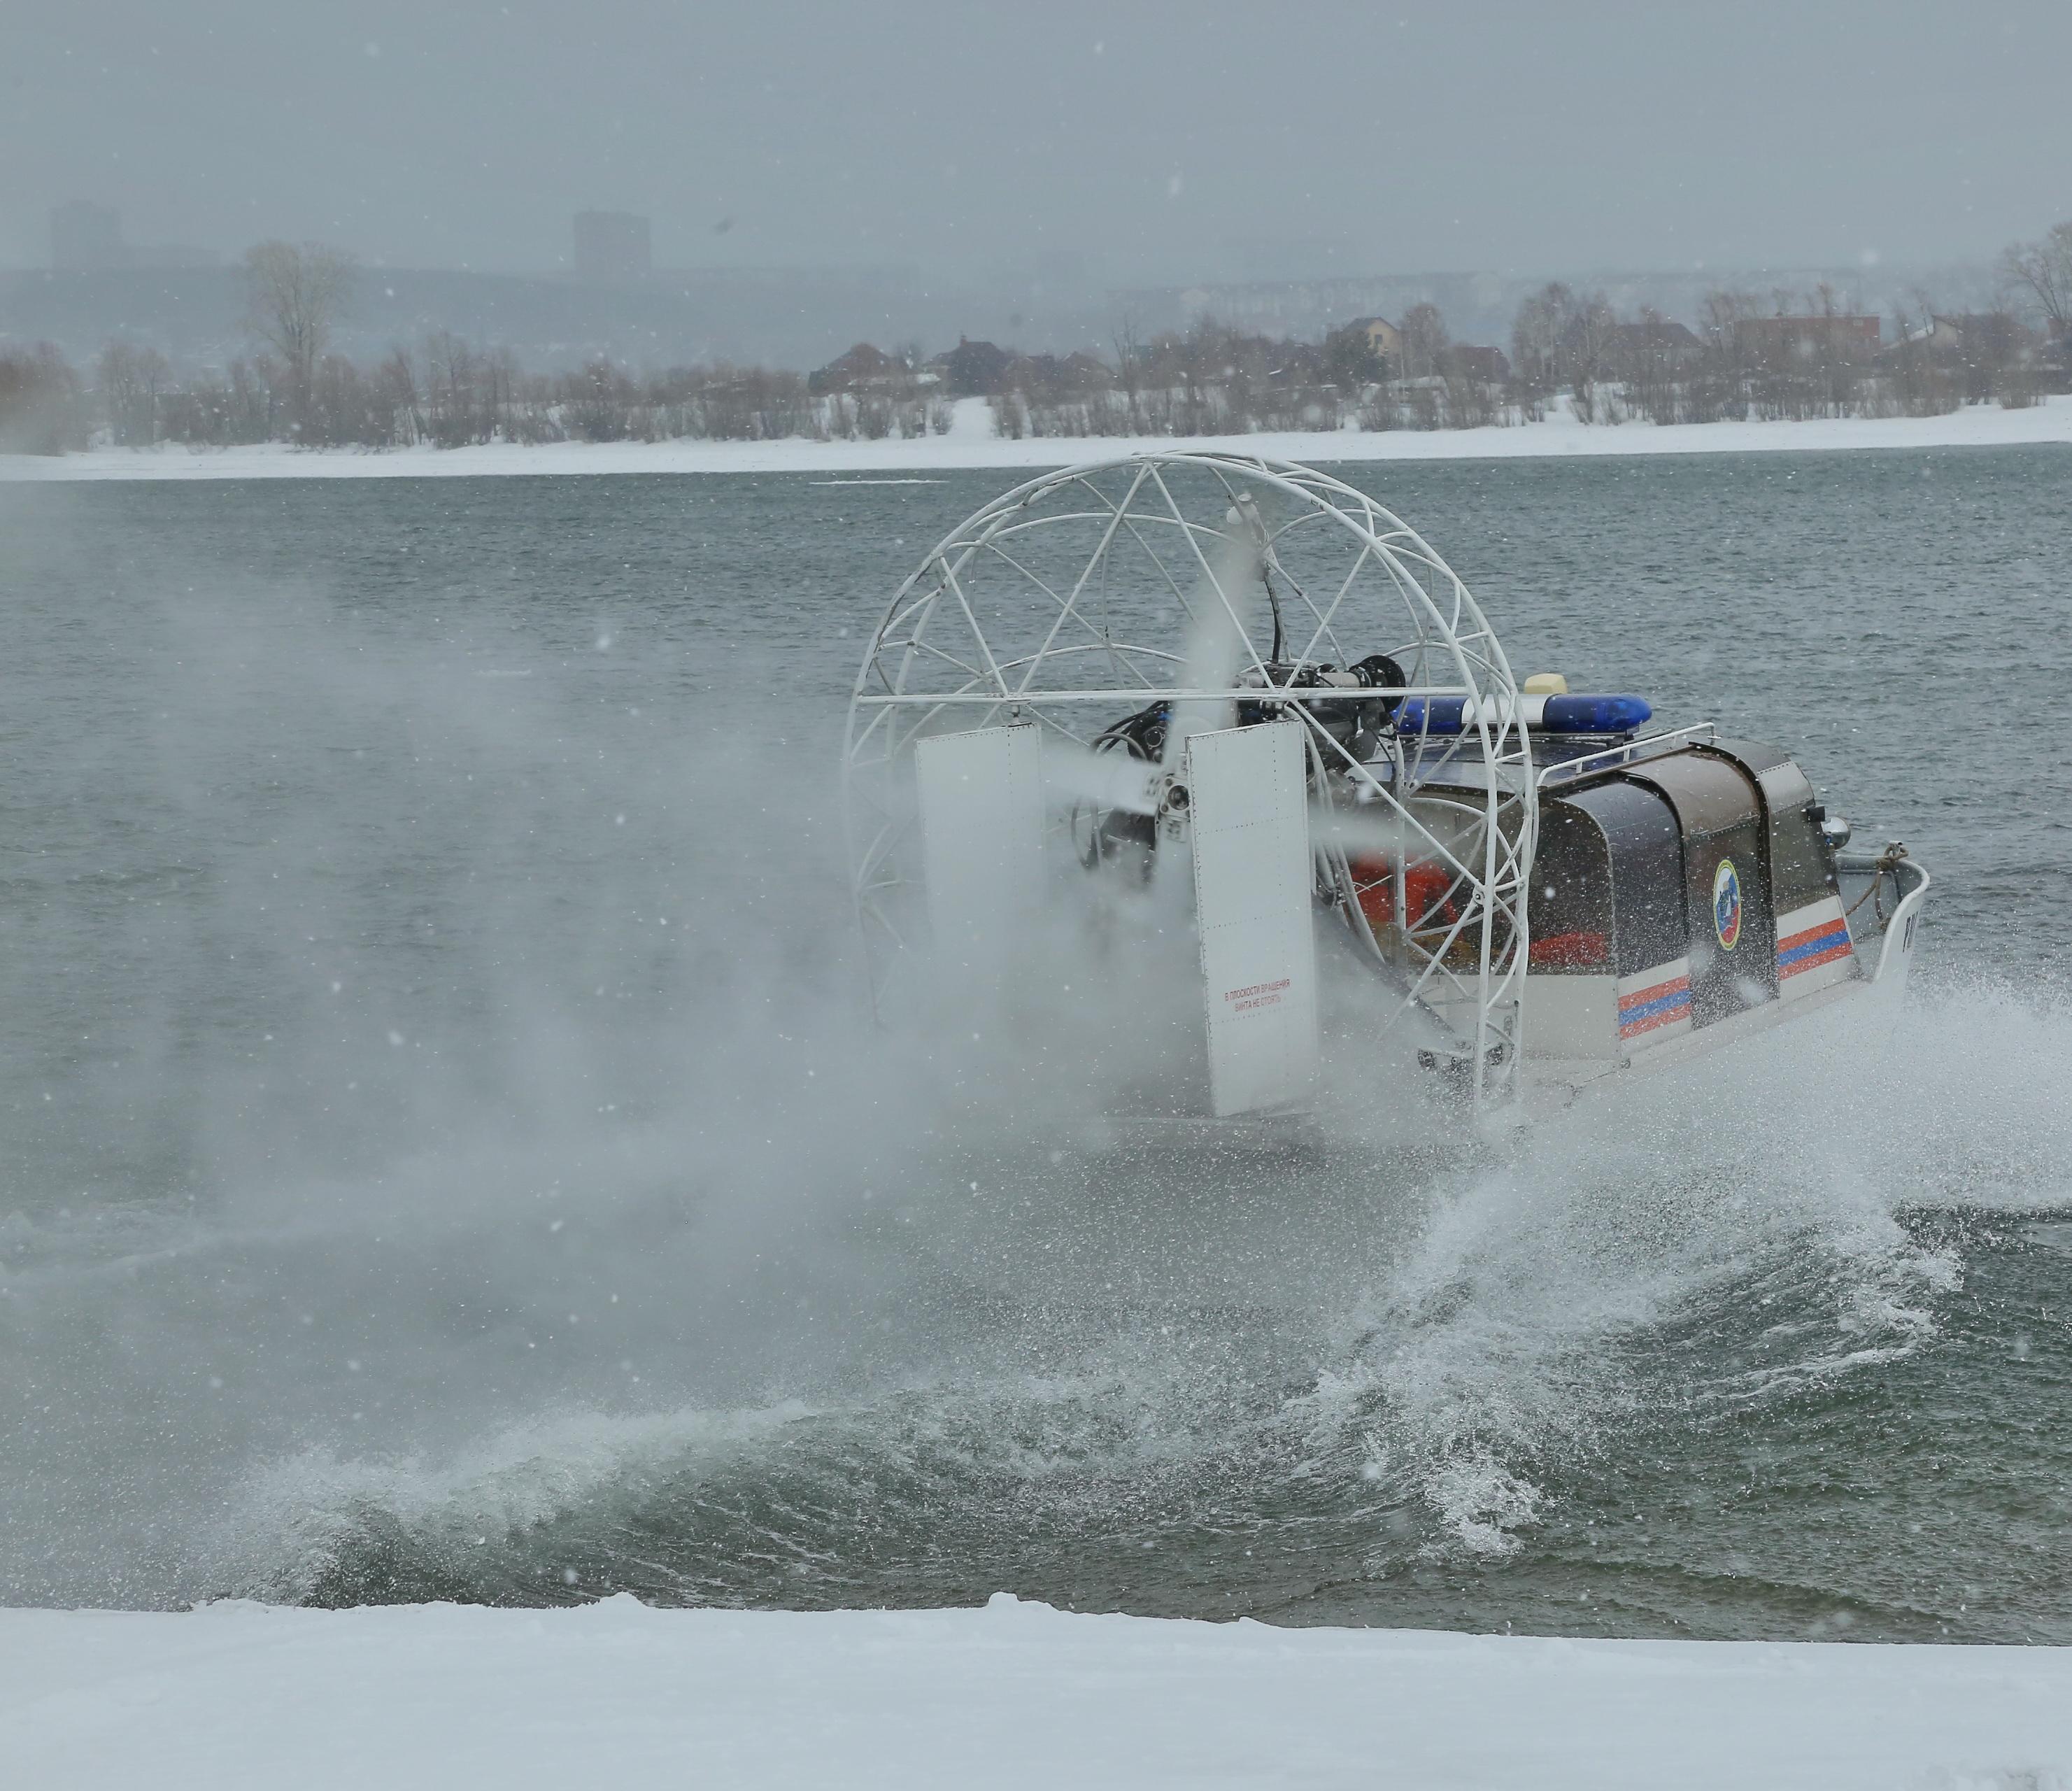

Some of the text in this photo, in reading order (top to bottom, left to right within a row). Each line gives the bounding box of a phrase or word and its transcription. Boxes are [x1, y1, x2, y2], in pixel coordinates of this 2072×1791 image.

[1225, 979, 1290, 1001] В ПЛОСКОСТИ ВРАЩЕНИЯ
[1235, 994, 1281, 1012] ВИНТА НЕ СТОЯТЬ
